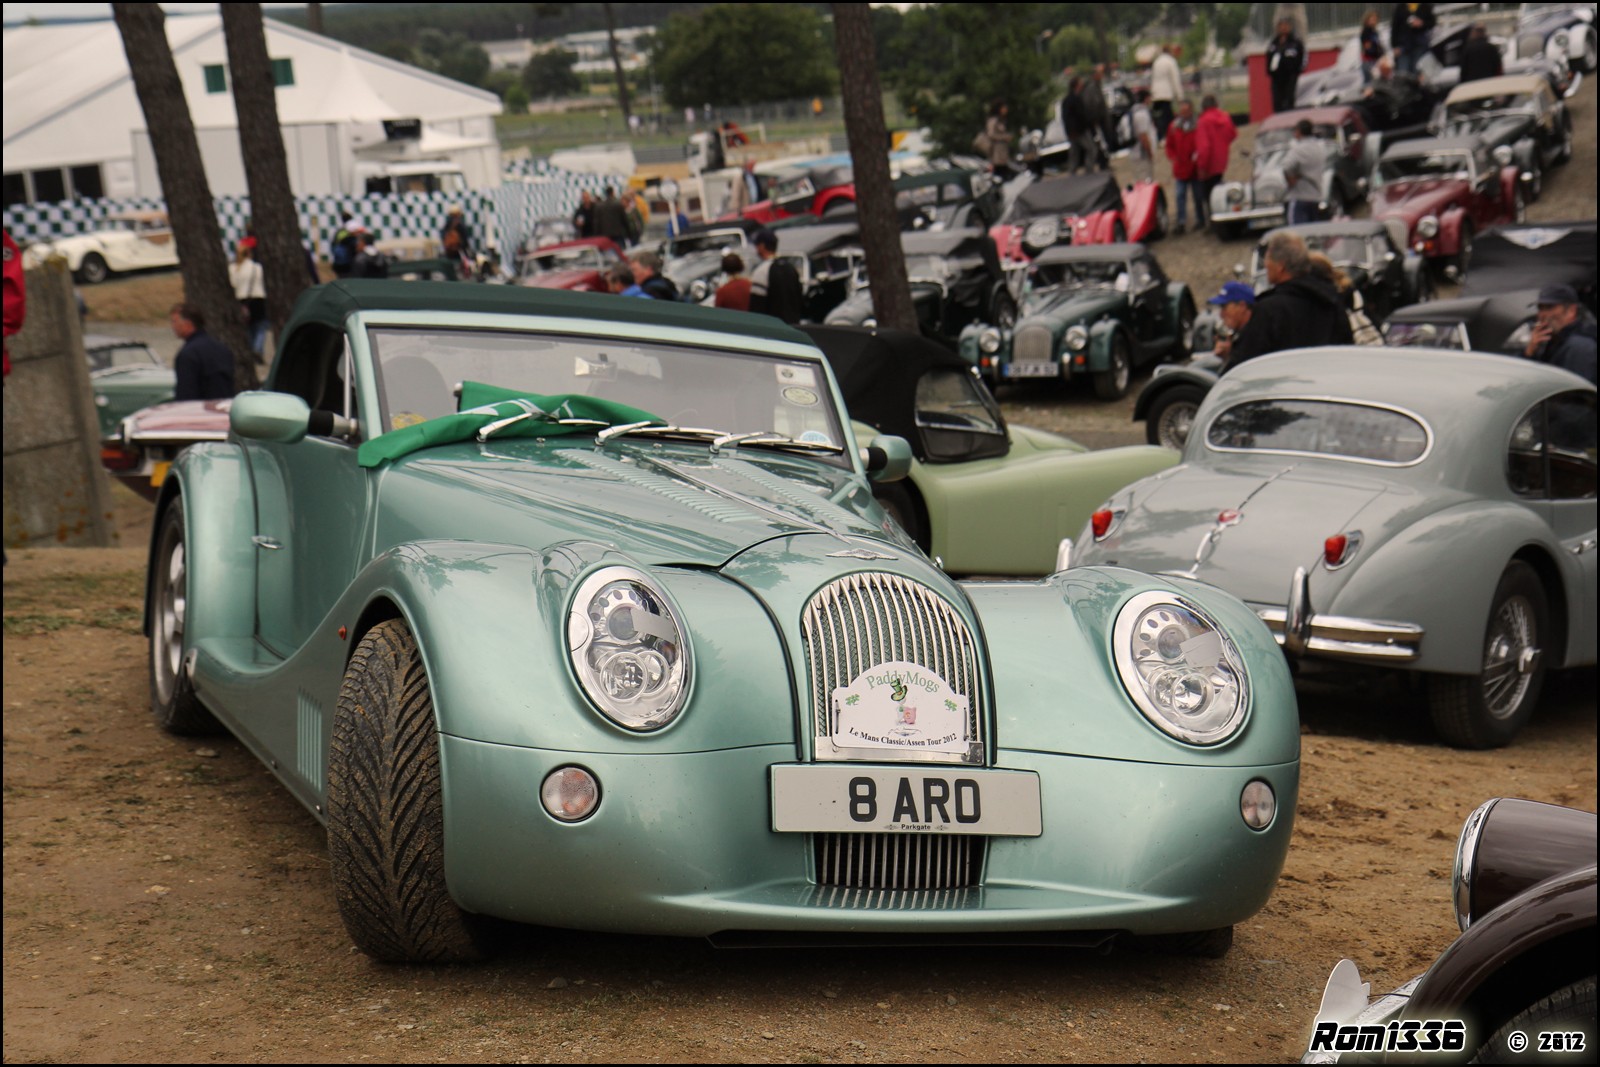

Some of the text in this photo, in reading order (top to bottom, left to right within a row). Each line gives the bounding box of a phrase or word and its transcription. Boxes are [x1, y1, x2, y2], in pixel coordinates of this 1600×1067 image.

[866, 670, 940, 693] PaddyMogs
[848, 727, 957, 746] Le Mans Classic/Assen Tour 2012
[849, 777, 981, 823] 8 ARO
